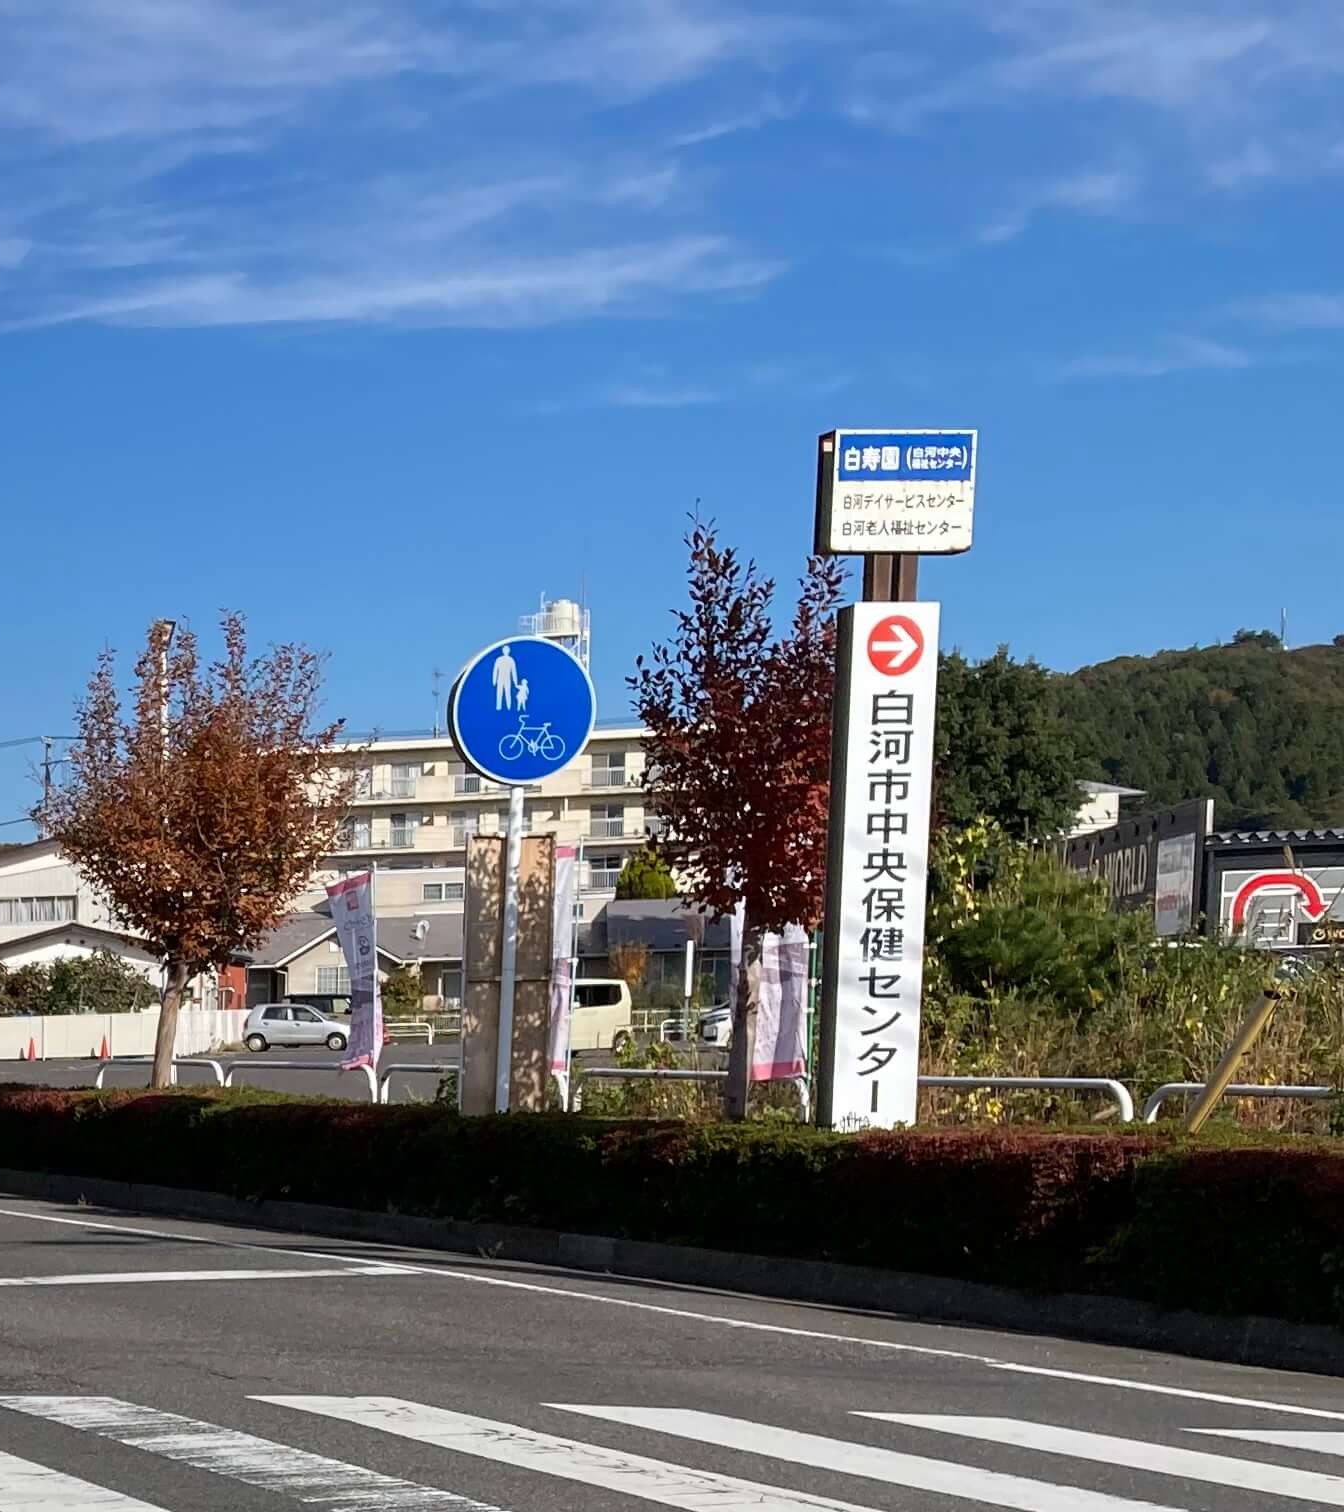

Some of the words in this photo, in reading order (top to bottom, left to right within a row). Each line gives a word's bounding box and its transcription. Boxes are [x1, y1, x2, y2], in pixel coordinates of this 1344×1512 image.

[843, 494, 964, 511] 白河デイサービスセンター
[842, 519, 962, 536] 白河老人福祉センター
[856, 689, 915, 1114] 白河市中央保健センター
